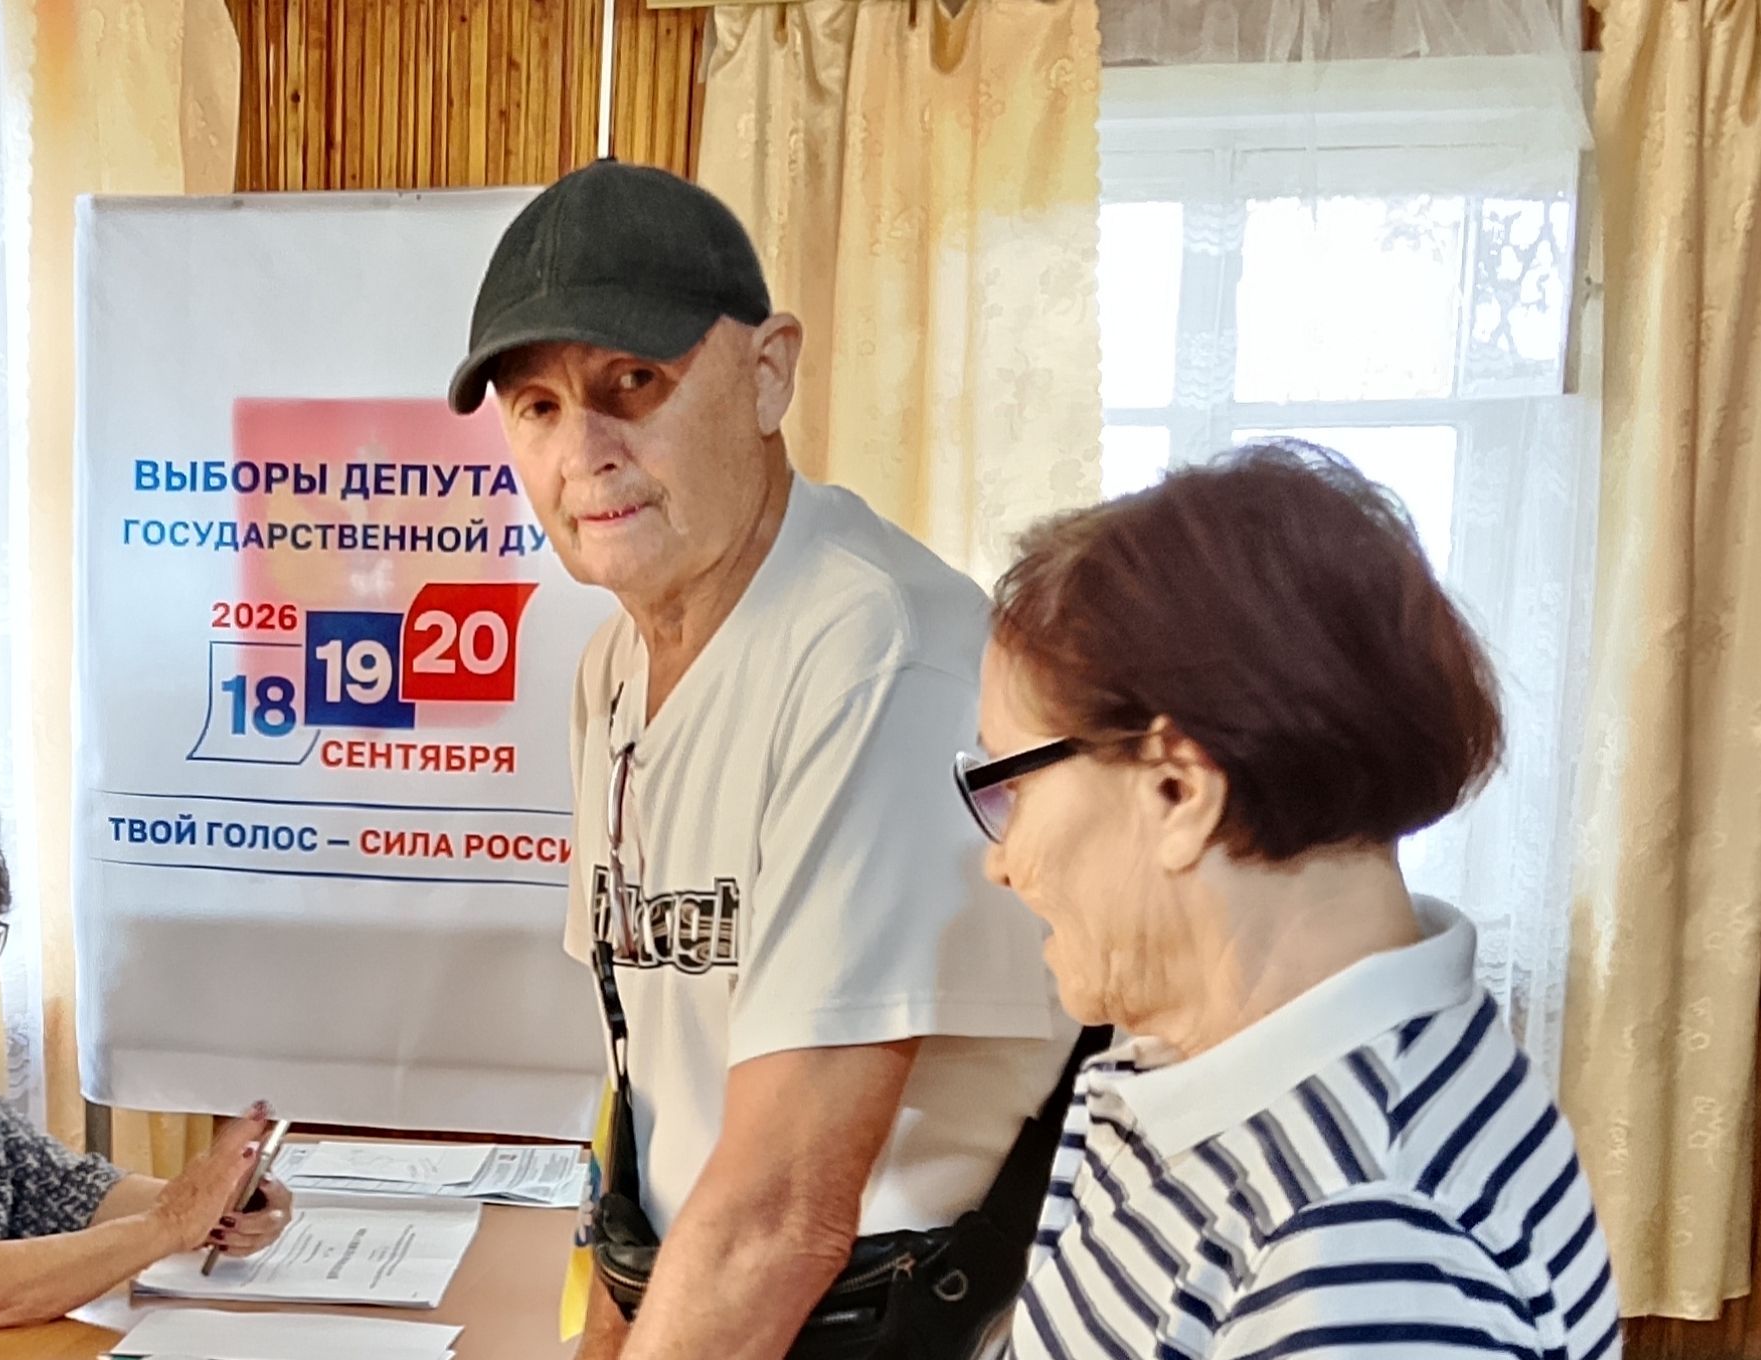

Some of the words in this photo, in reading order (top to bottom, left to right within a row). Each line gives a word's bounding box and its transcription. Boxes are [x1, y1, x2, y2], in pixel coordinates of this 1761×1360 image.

[134, 459, 328, 495] ВЫБОРЫ
[340, 462, 518, 500] ДЕПУТА
[123, 517, 489, 552] ГОСУДАРСТВЕННОЙ
[499, 523, 547, 556] ДУ
[211, 602, 298, 631] 2026
[221, 674, 296, 737] 18
[315, 639, 393, 704] 19
[412, 610, 509, 675] 20
[320, 739, 516, 774] СЕНТЯБРЯ
[108, 814, 197, 847] ТВОЙ
[206, 822, 318, 852] ГОЛОС
[359, 829, 453, 859] СИЛА
[464, 833, 572, 865] РОССИ
